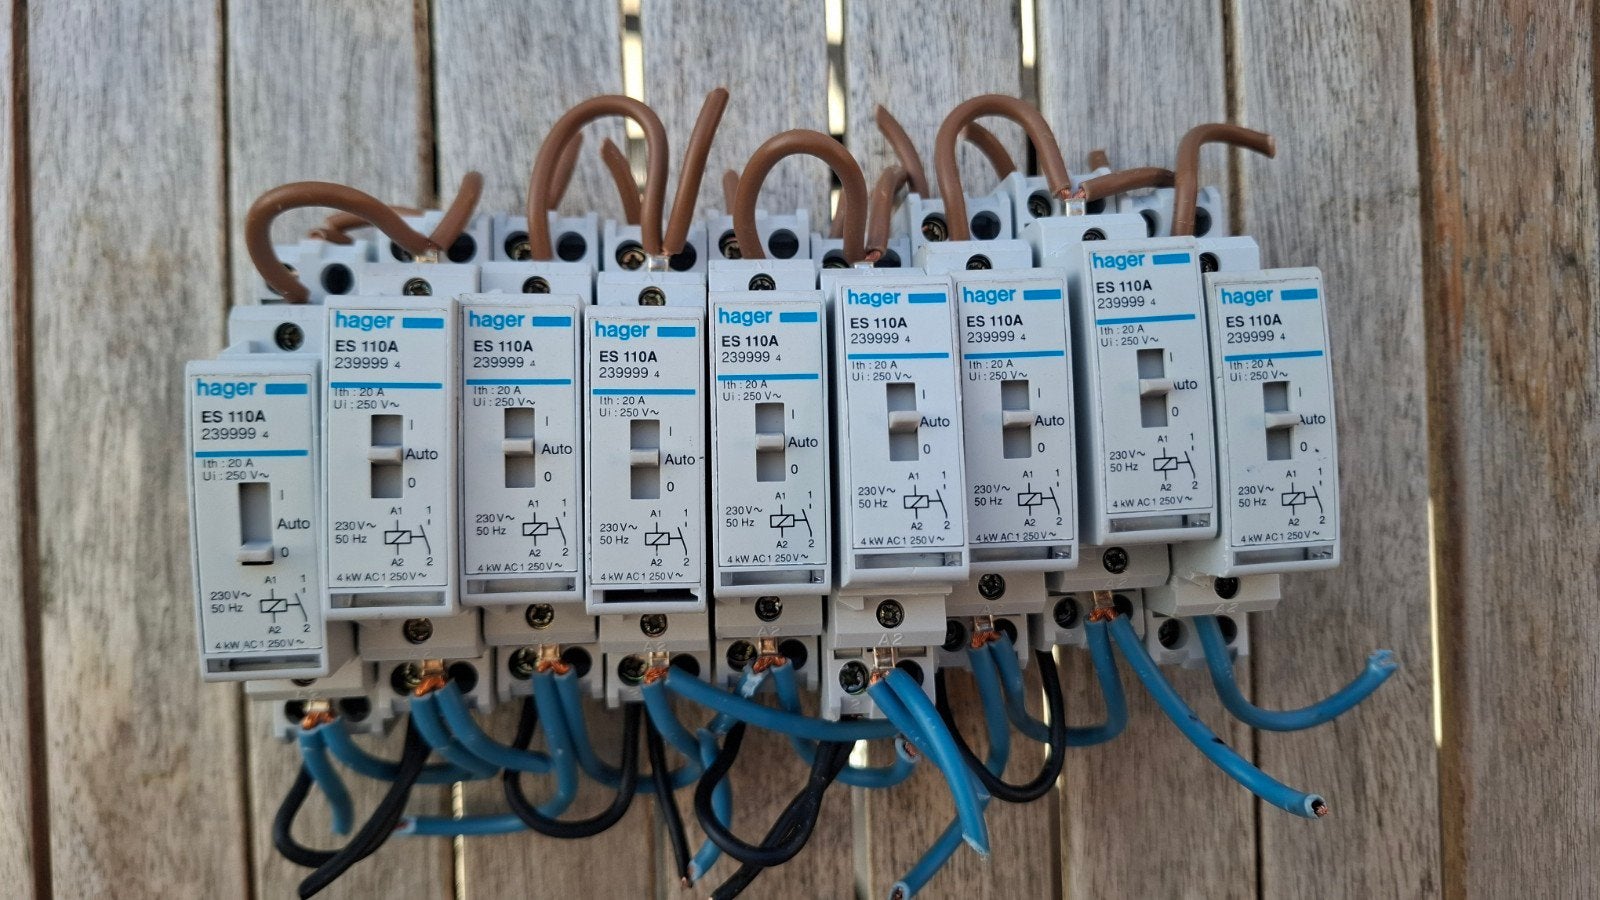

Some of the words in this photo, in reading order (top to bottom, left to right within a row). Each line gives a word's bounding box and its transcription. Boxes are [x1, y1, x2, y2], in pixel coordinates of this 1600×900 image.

[1093, 253, 1145, 270] hager
[1096, 282, 1114, 293] ES
[1120, 280, 1152, 292] 110A
[848, 289, 901, 307] hager
[963, 287, 1016, 305] hager
[1221, 288, 1273, 306] hager
[1098, 296, 1144, 309] 239999
[336, 311, 394, 331] hager
[469, 311, 525, 330] hager
[719, 308, 772, 326] hager
[967, 316, 985, 327] ES
[990, 315, 1023, 326] 110A
[1226, 316, 1244, 328] ES
[1249, 314, 1282, 326] 110A
[851, 318, 869, 328] ES
[874, 317, 907, 328] 110A
[595, 321, 650, 340] hager
[1123, 326, 1134, 334] 20
[722, 336, 740, 347] ES
[745, 335, 778, 346] 110A
[851, 333, 899, 344] 239999
[967, 331, 1014, 343] 239999
[1227, 330, 1274, 344] 239999
[335, 340, 356, 352] ES
[362, 341, 398, 352] 110A
[474, 340, 493, 352] ES
[499, 340, 533, 352] 110A
[600, 351, 618, 362] ES
[624, 351, 657, 362] 110A
[722, 351, 769, 362] 239999
[335, 357, 388, 369] 239999
[474, 357, 524, 368] 239999
[875, 361, 886, 369] 20
[991, 360, 1002, 368] 20
[1252, 360, 1263, 368] 20
[599, 367, 648, 378] 239999
[196, 378, 257, 399] hager
[360, 388, 373, 396] 20
[498, 386, 510, 394] 20
[623, 396, 634, 404] 20
[202, 411, 223, 423] ES
[228, 410, 266, 422] 110A
[1172, 407, 1178, 416] 0
[920, 417, 950, 427] Auto
[1035, 416, 1064, 426] Auto
[202, 428, 256, 440] 239999
[788, 437, 818, 447] Auto
[1301, 442, 1307, 451] 0
[541, 444, 572, 454] Auto
[924, 444, 930, 454] 0
[1038, 443, 1044, 452] 0
[405, 448, 438, 459] Auto
[228, 459, 242, 467] 20
[665, 454, 695, 465] Auto
[791, 464, 798, 474] 0
[1110, 464, 1122, 472] 50
[1126, 463, 1138, 471] Hz
[544, 472, 551, 481] 0
[908, 472, 919, 480] A1
[1286, 470, 1296, 478] A1
[408, 478, 416, 488] 0
[667, 482, 674, 491] 0
[1192, 481, 1198, 489] 2
[775, 492, 785, 500] A1
[859, 500, 871, 508] 50
[875, 500, 887, 508] Hz
[974, 498, 986, 506] 50
[990, 497, 1002, 505] Hz
[1239, 499, 1250, 507] 50
[1254, 498, 1266, 506] Hz
[277, 518, 310, 529] Auto
[726, 519, 738, 527] 50
[944, 521, 950, 529] 2
[1056, 517, 1062, 525] 2
[1288, 518, 1299, 526] A2
[1319, 516, 1325, 524] 2
[476, 527, 489, 535] 50
[493, 527, 506, 535] Hz
[336, 535, 348, 543] 50
[353, 534, 367, 543] Hz
[600, 536, 612, 544] 50
[616, 536, 628, 544] Hz
[809, 539, 814, 547] 2
[281, 547, 289, 557] 0
[529, 549, 541, 557] A2
[563, 548, 568, 556] 2
[391, 558, 403, 566] A2
[427, 558, 433, 566] 2
[684, 558, 689, 566] 2
[212, 605, 225, 613] 50
[229, 604, 243, 612] Hz
[304, 624, 310, 632] 2
[879, 633, 904, 645] A2
